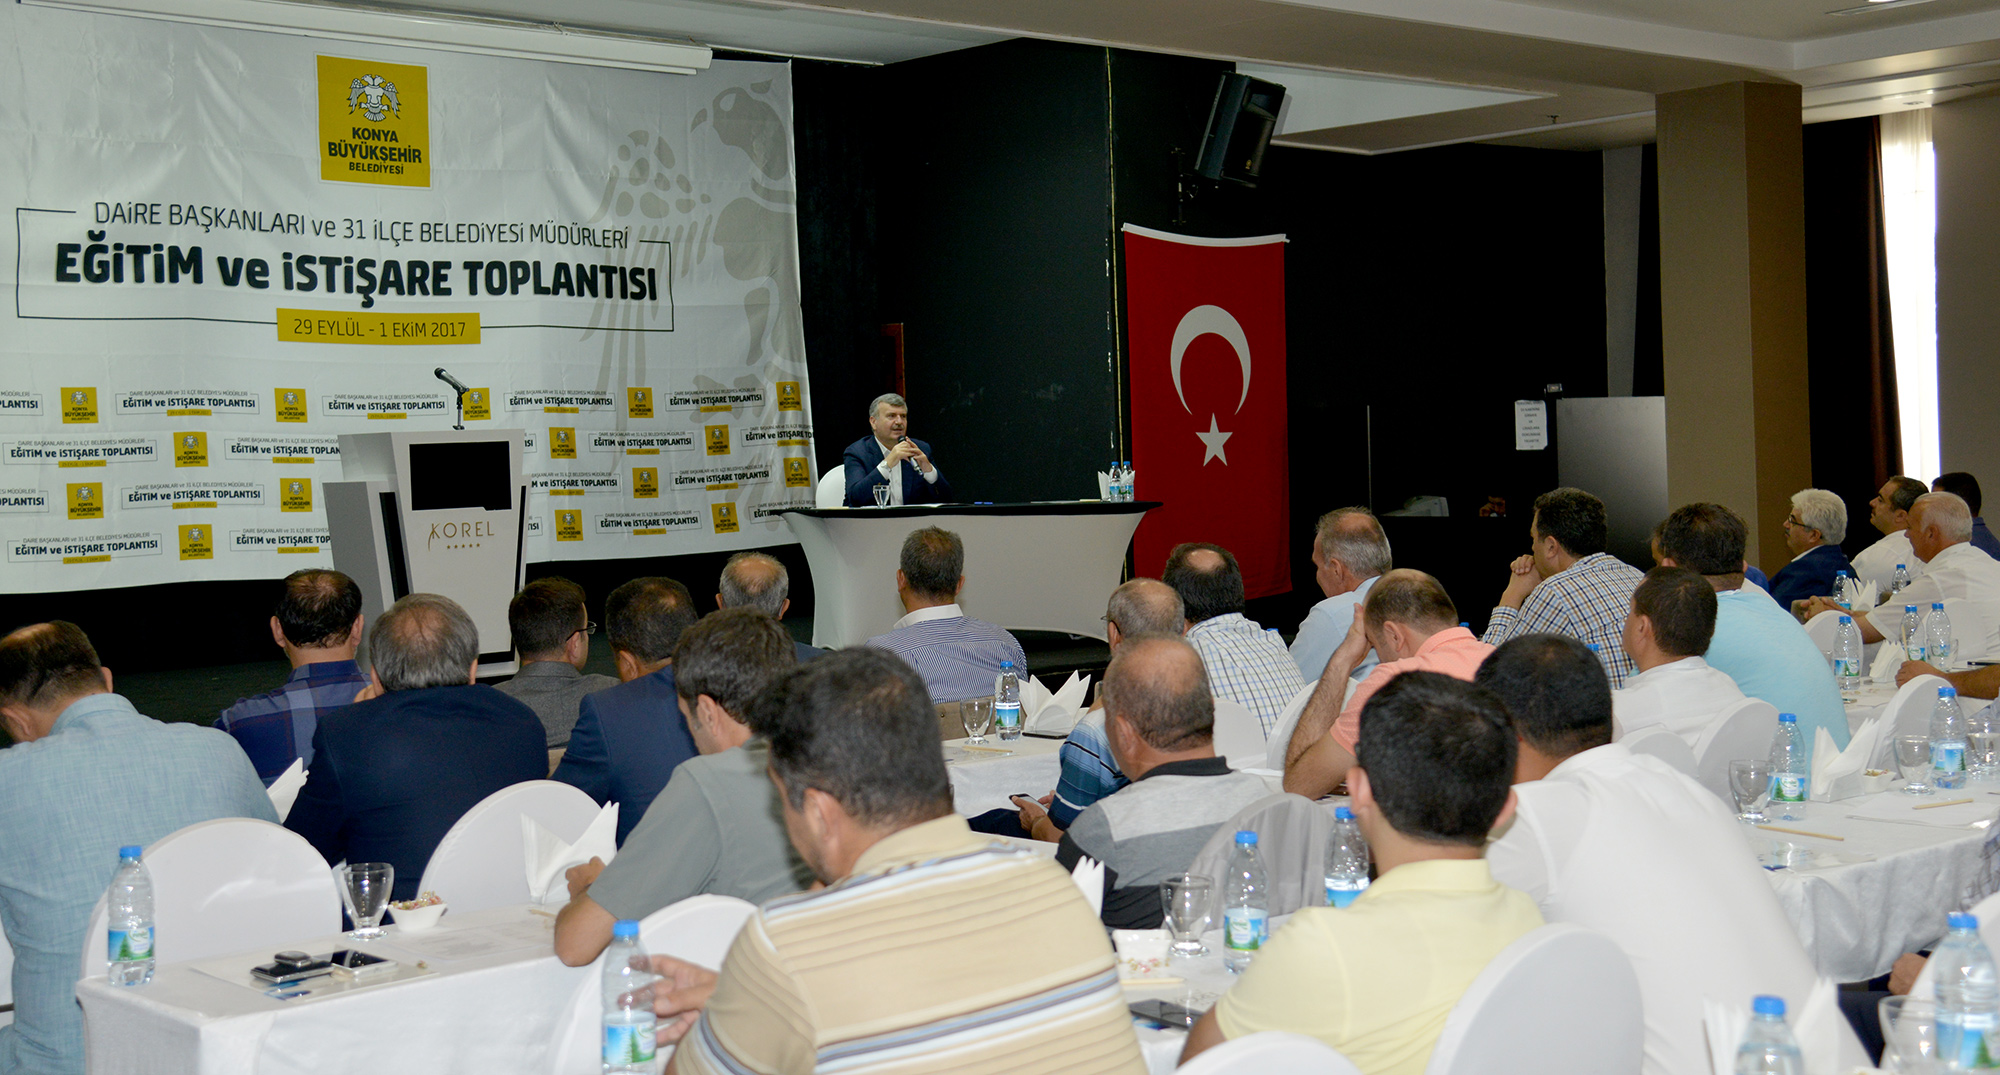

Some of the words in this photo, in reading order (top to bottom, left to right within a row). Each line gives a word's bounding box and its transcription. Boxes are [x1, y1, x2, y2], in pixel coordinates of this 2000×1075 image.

[352, 127, 398, 142] KONYA
[328, 140, 422, 163] BÜYÜKŞEHİR
[349, 162, 404, 174] BELEDİYESİ
[170, 204, 305, 234] BAŞKANLARI
[312, 220, 336, 238] ve
[344, 219, 366, 239] 31
[218, 256, 270, 288] ve
[464, 260, 657, 300] TOPLANTISI
[294, 318, 312, 334] 29
[318, 317, 364, 337] EYLÜL
[380, 322, 386, 337] 1
[431, 322, 466, 337] 2017
[208, 398, 255, 407] TOPLANTISI
[403, 401, 445, 410] TOPLANTISI
[656, 438, 692, 446] TOPLANTISI
[102, 446, 153, 456] TOPLANTISI
[310, 446, 340, 454] TOPLAN
[213, 490, 261, 498] TOPLANTISI
[662, 516, 698, 525] TOPLANTISI
[428, 521, 495, 550] KOREL
[106, 540, 158, 551] TOPLANTISI
